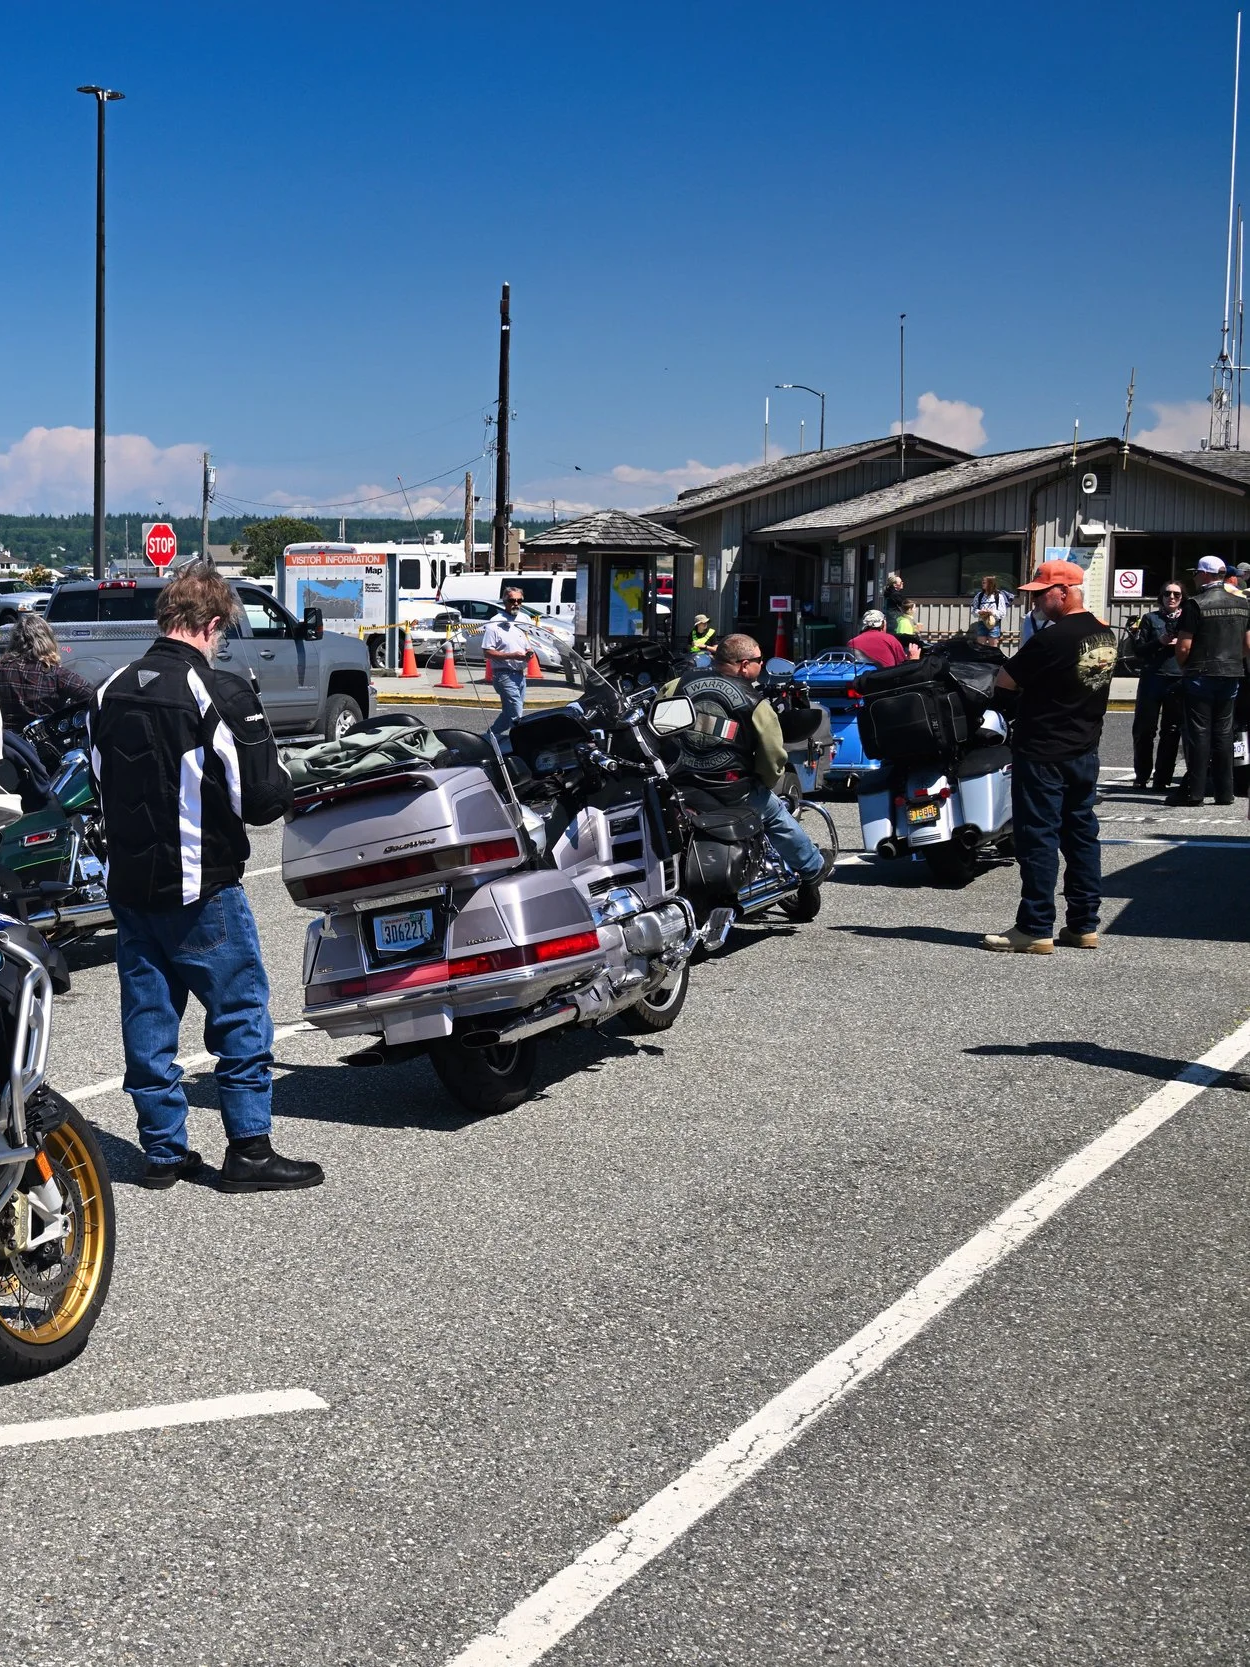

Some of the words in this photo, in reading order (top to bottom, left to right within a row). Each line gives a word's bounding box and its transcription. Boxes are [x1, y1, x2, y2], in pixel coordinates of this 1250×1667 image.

[148, 537, 175, 554] STOP
[291, 556, 322, 565] VISITOR
[325, 555, 380, 564] INFORMATION
[365, 566, 383, 575] Map
[690, 680, 739, 701] WARRIOR
